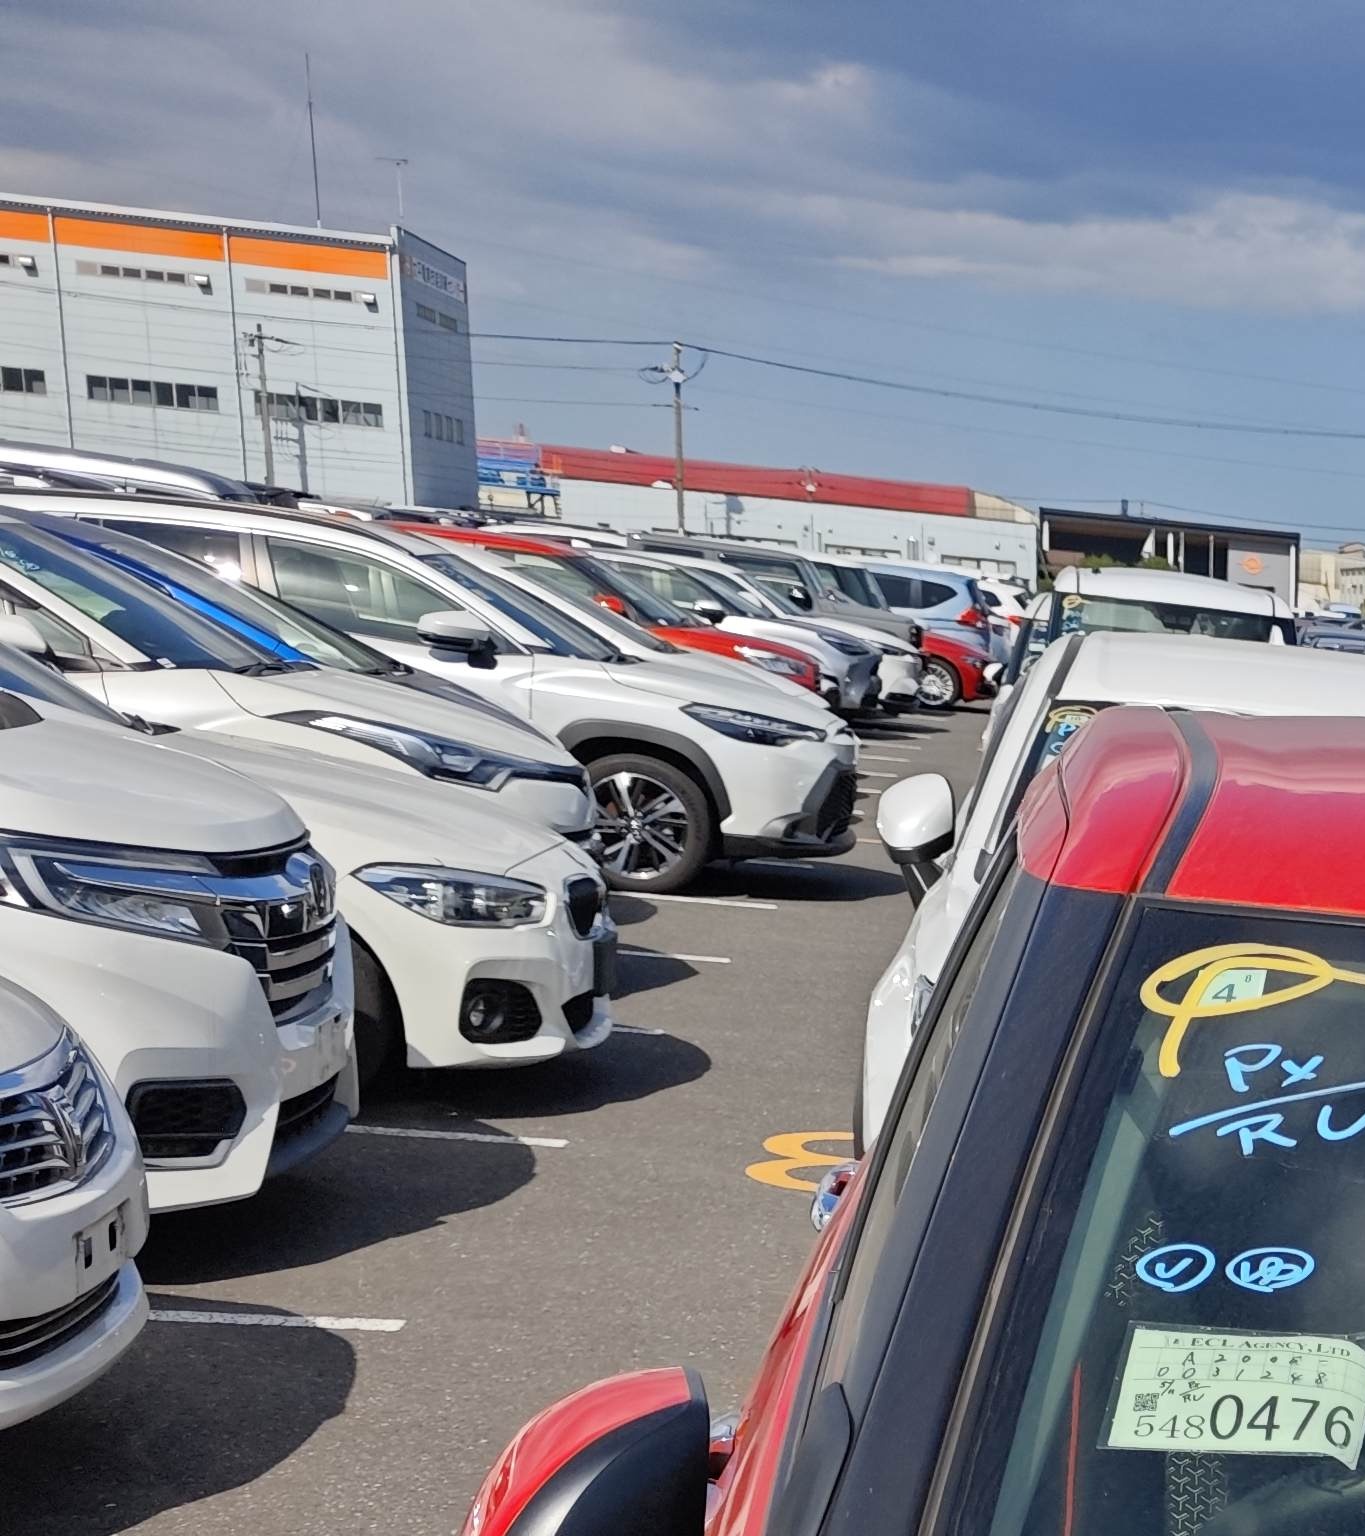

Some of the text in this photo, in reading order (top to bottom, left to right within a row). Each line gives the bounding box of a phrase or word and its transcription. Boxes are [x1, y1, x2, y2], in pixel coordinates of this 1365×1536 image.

[1190, 1337, 1234, 1347] ECL
[1133, 1394, 1355, 1449] 548 0476
